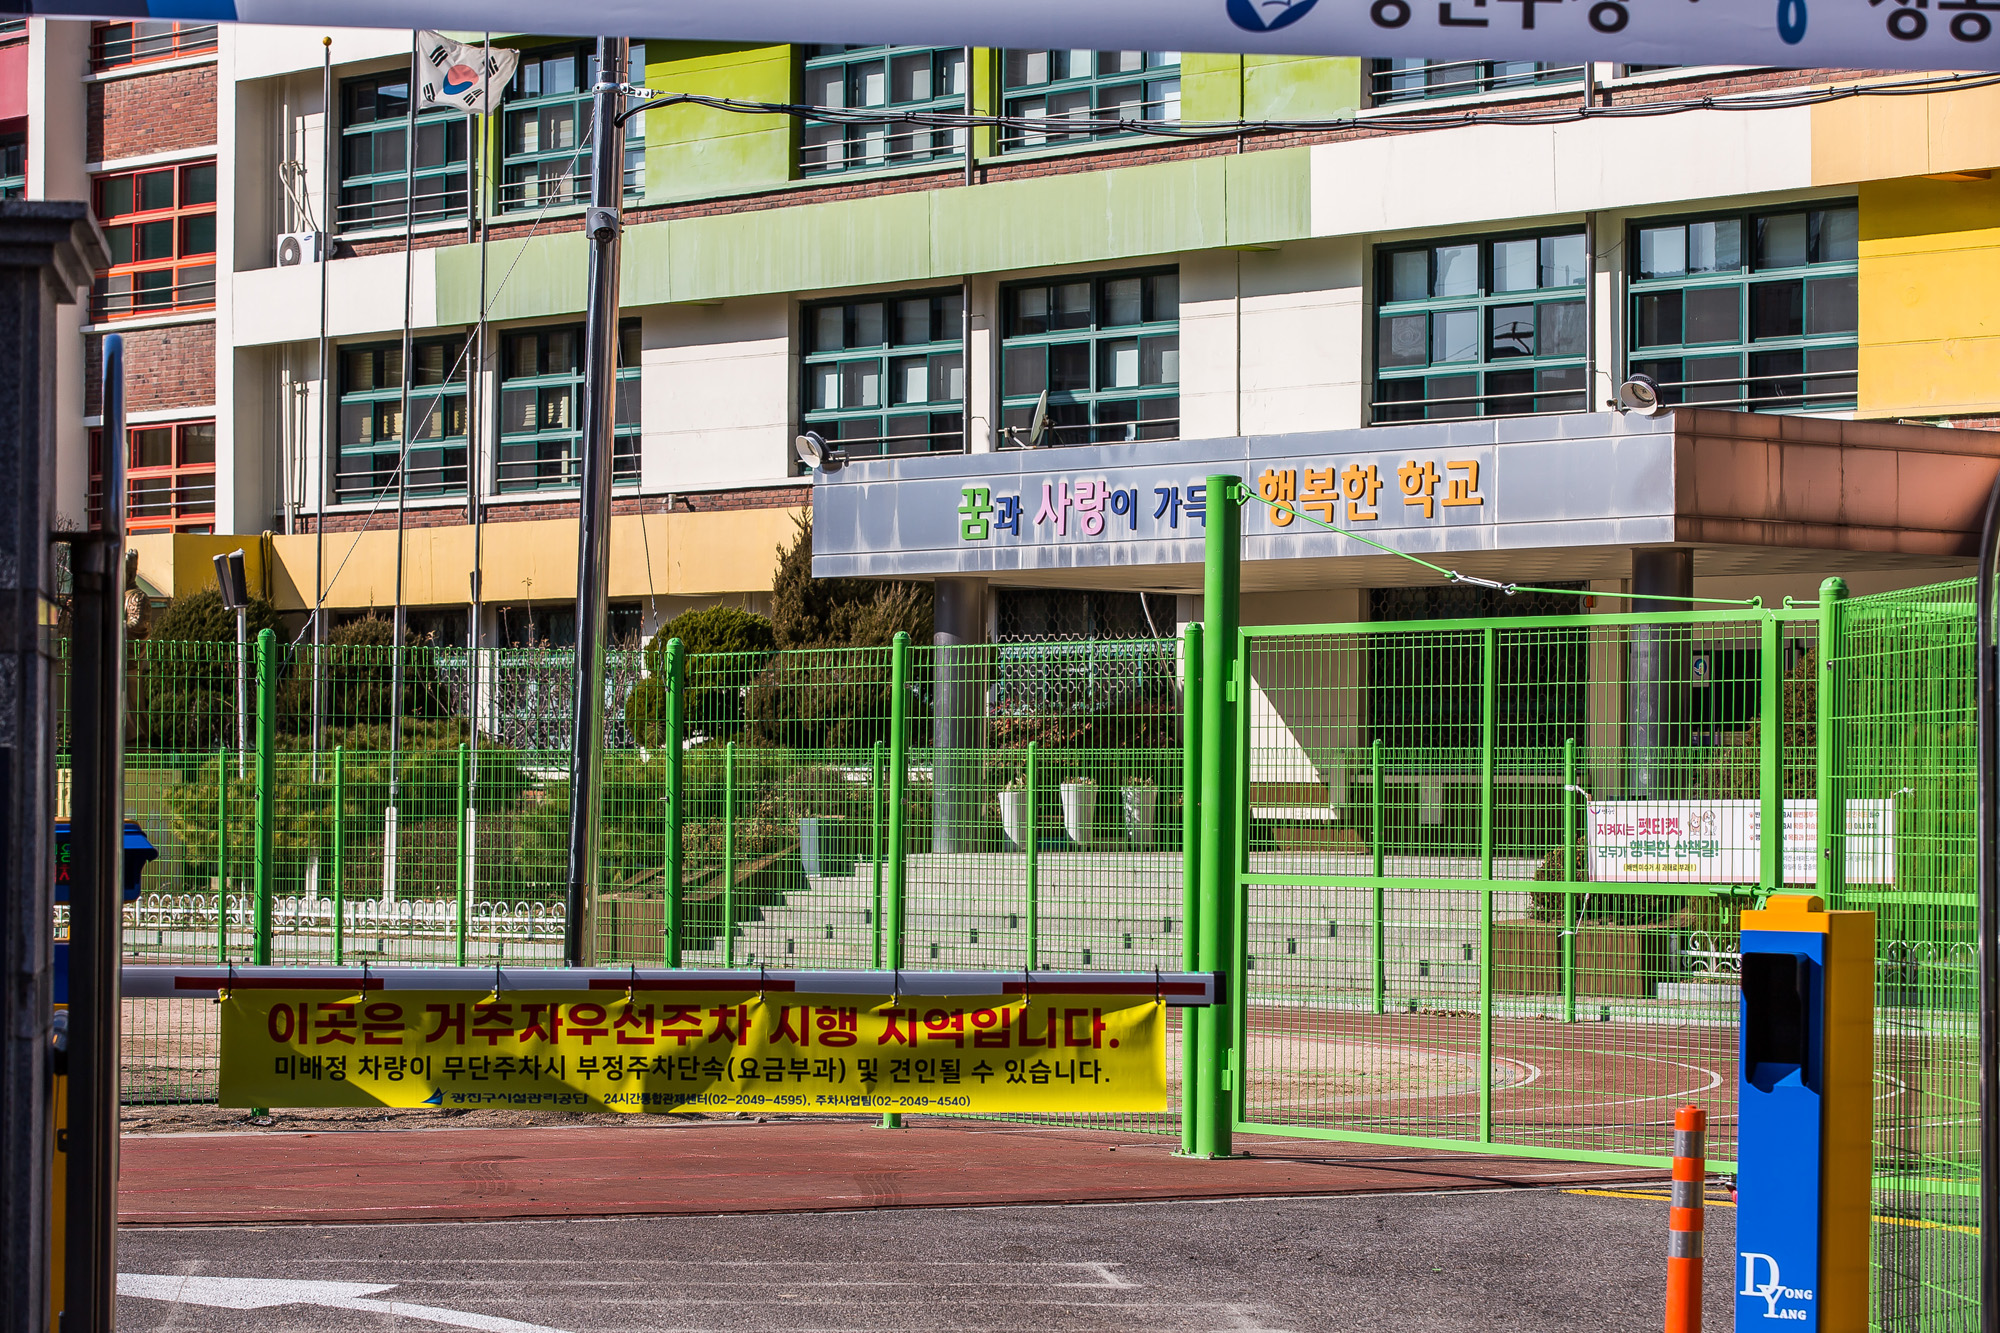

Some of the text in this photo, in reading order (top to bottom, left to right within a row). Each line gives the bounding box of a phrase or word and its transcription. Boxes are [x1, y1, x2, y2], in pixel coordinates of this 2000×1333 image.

[957, 487, 1023, 541] 꿈과
[1033, 480, 1138, 536] 사랑이
[1258, 463, 1383, 527] 행복한
[1398, 460, 1483, 519] 학교
[1597, 817, 1683, 837] 지켜지는 펫티켓,
[1598, 839, 1719, 858] 모두가 행복한 산책길!
[268, 1002, 1120, 1049] 이곳은 거주자우선주차 시행 지역입니다.
[275, 1055, 1110, 1084] 미배정 차량이 무단주차시 부정주차단속(요금부과) 및 견인될 수 있습니다.
